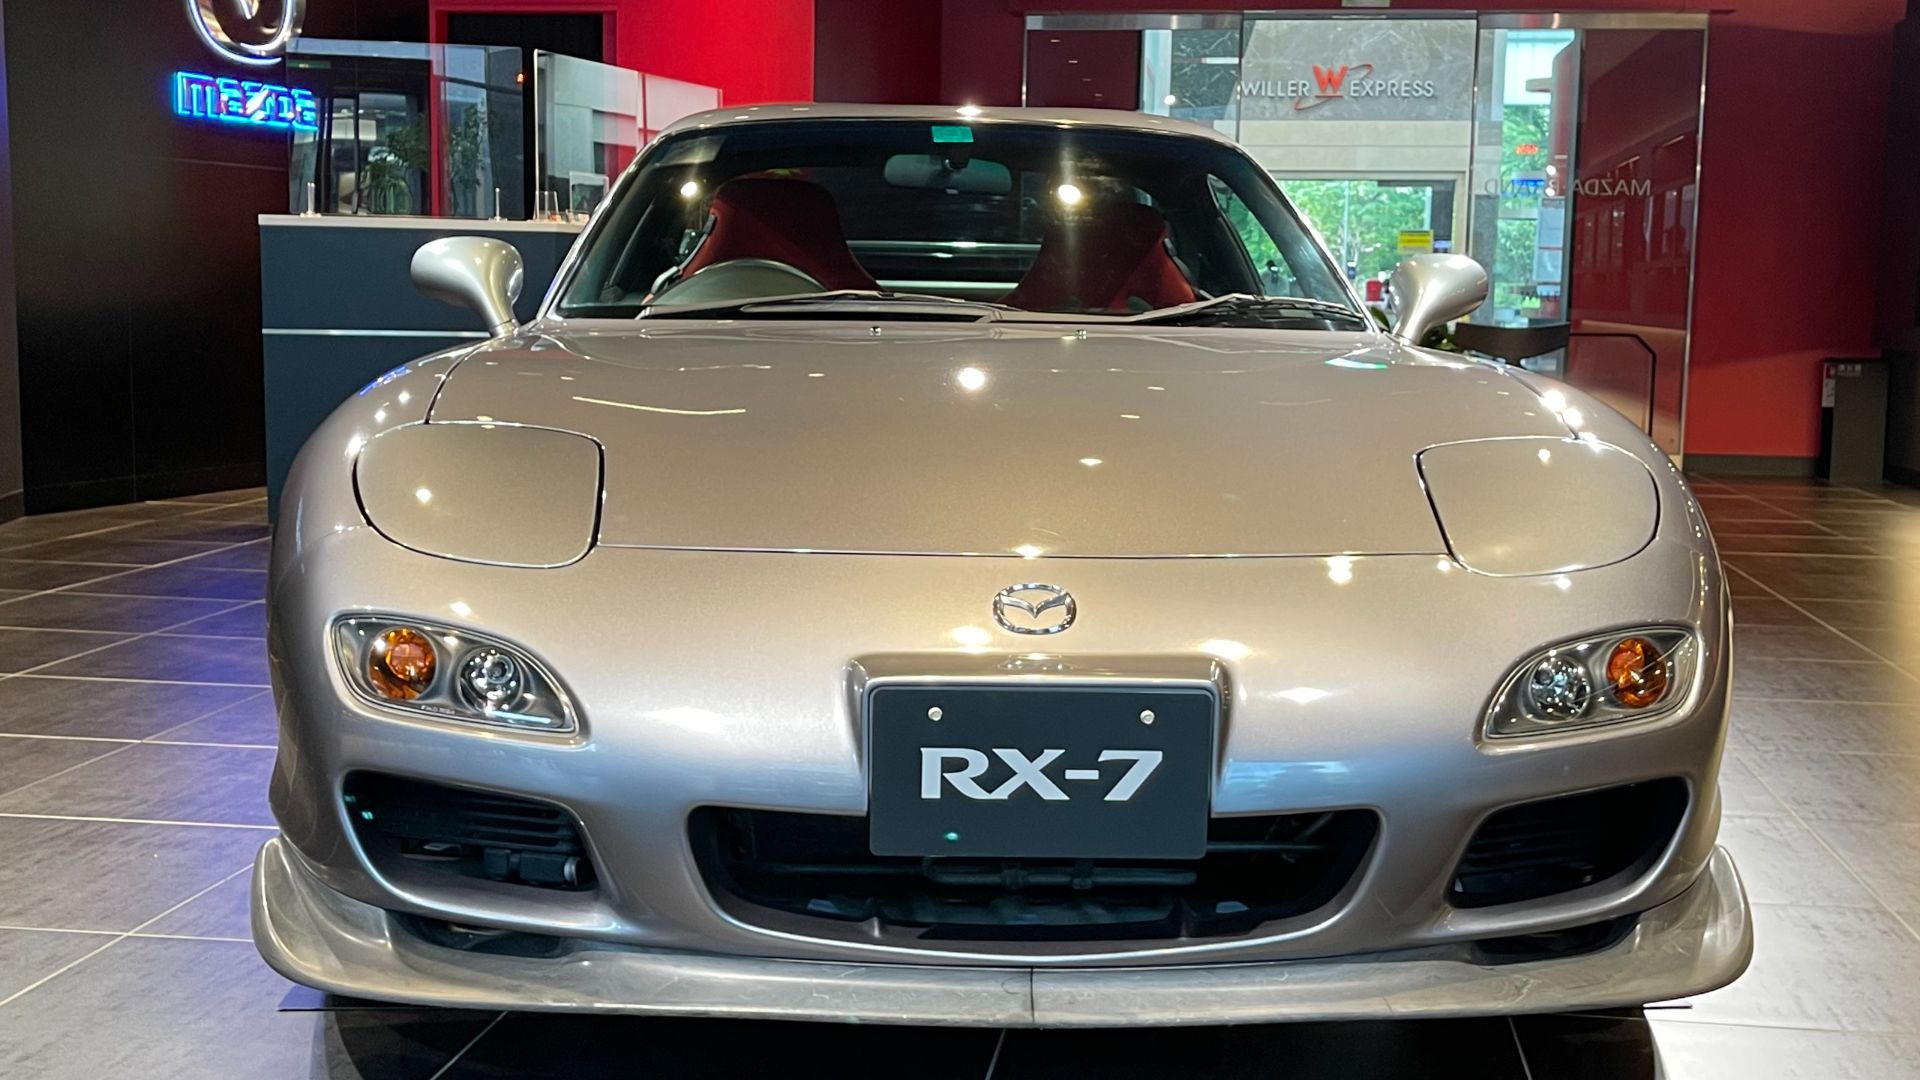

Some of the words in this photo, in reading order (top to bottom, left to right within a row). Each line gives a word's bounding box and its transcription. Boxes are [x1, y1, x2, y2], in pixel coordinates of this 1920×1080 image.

[1240, 79, 1310, 97] WILLER
[1350, 79, 1435, 98] EXPRESS
[920, 747, 1163, 801] RX-7
